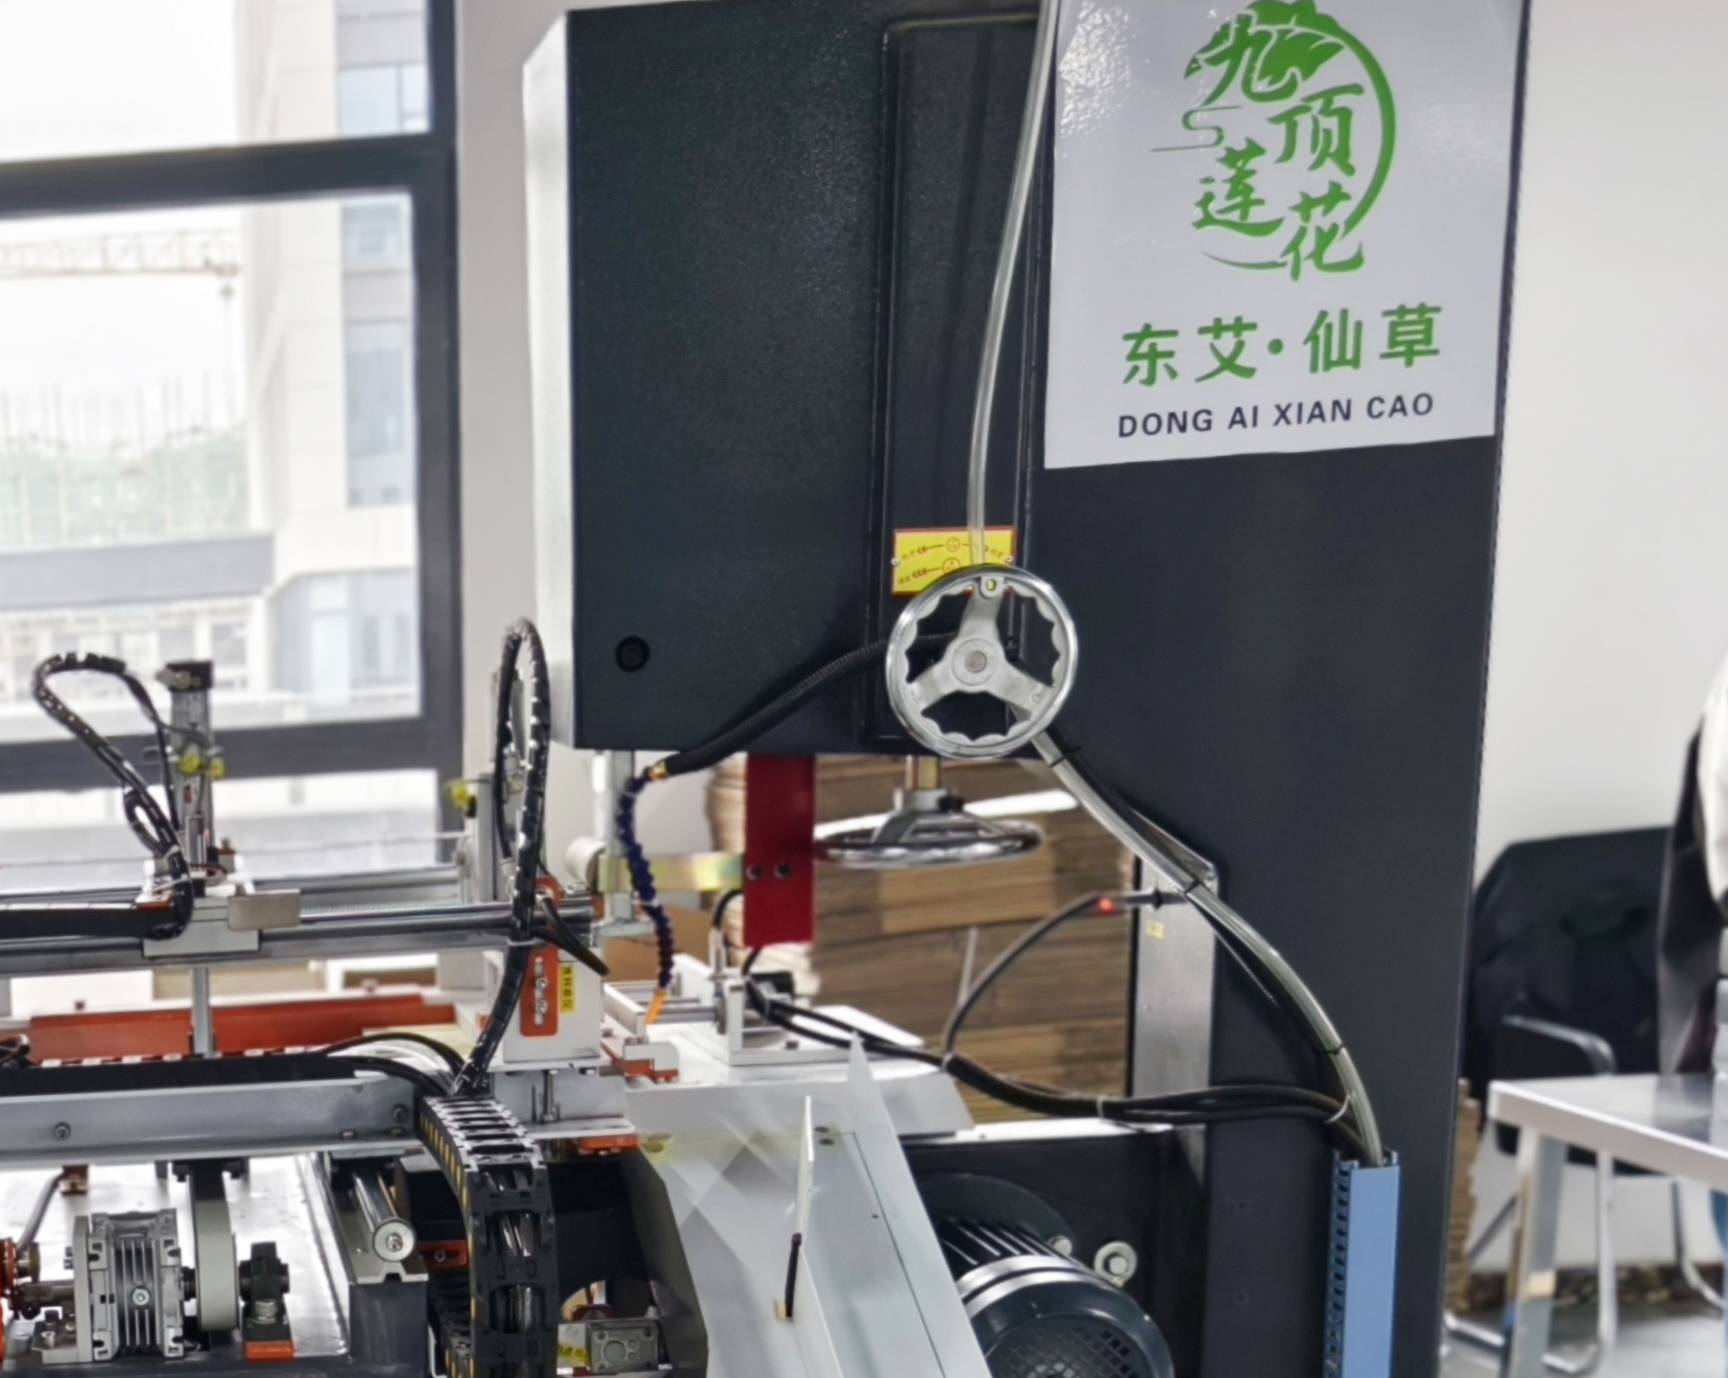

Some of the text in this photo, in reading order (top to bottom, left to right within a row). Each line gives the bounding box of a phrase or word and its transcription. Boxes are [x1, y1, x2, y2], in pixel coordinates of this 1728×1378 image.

[1121, 302, 1443, 387] 东艾·仙草
[1118, 392, 1434, 438] DONG AI XIAN CAO
